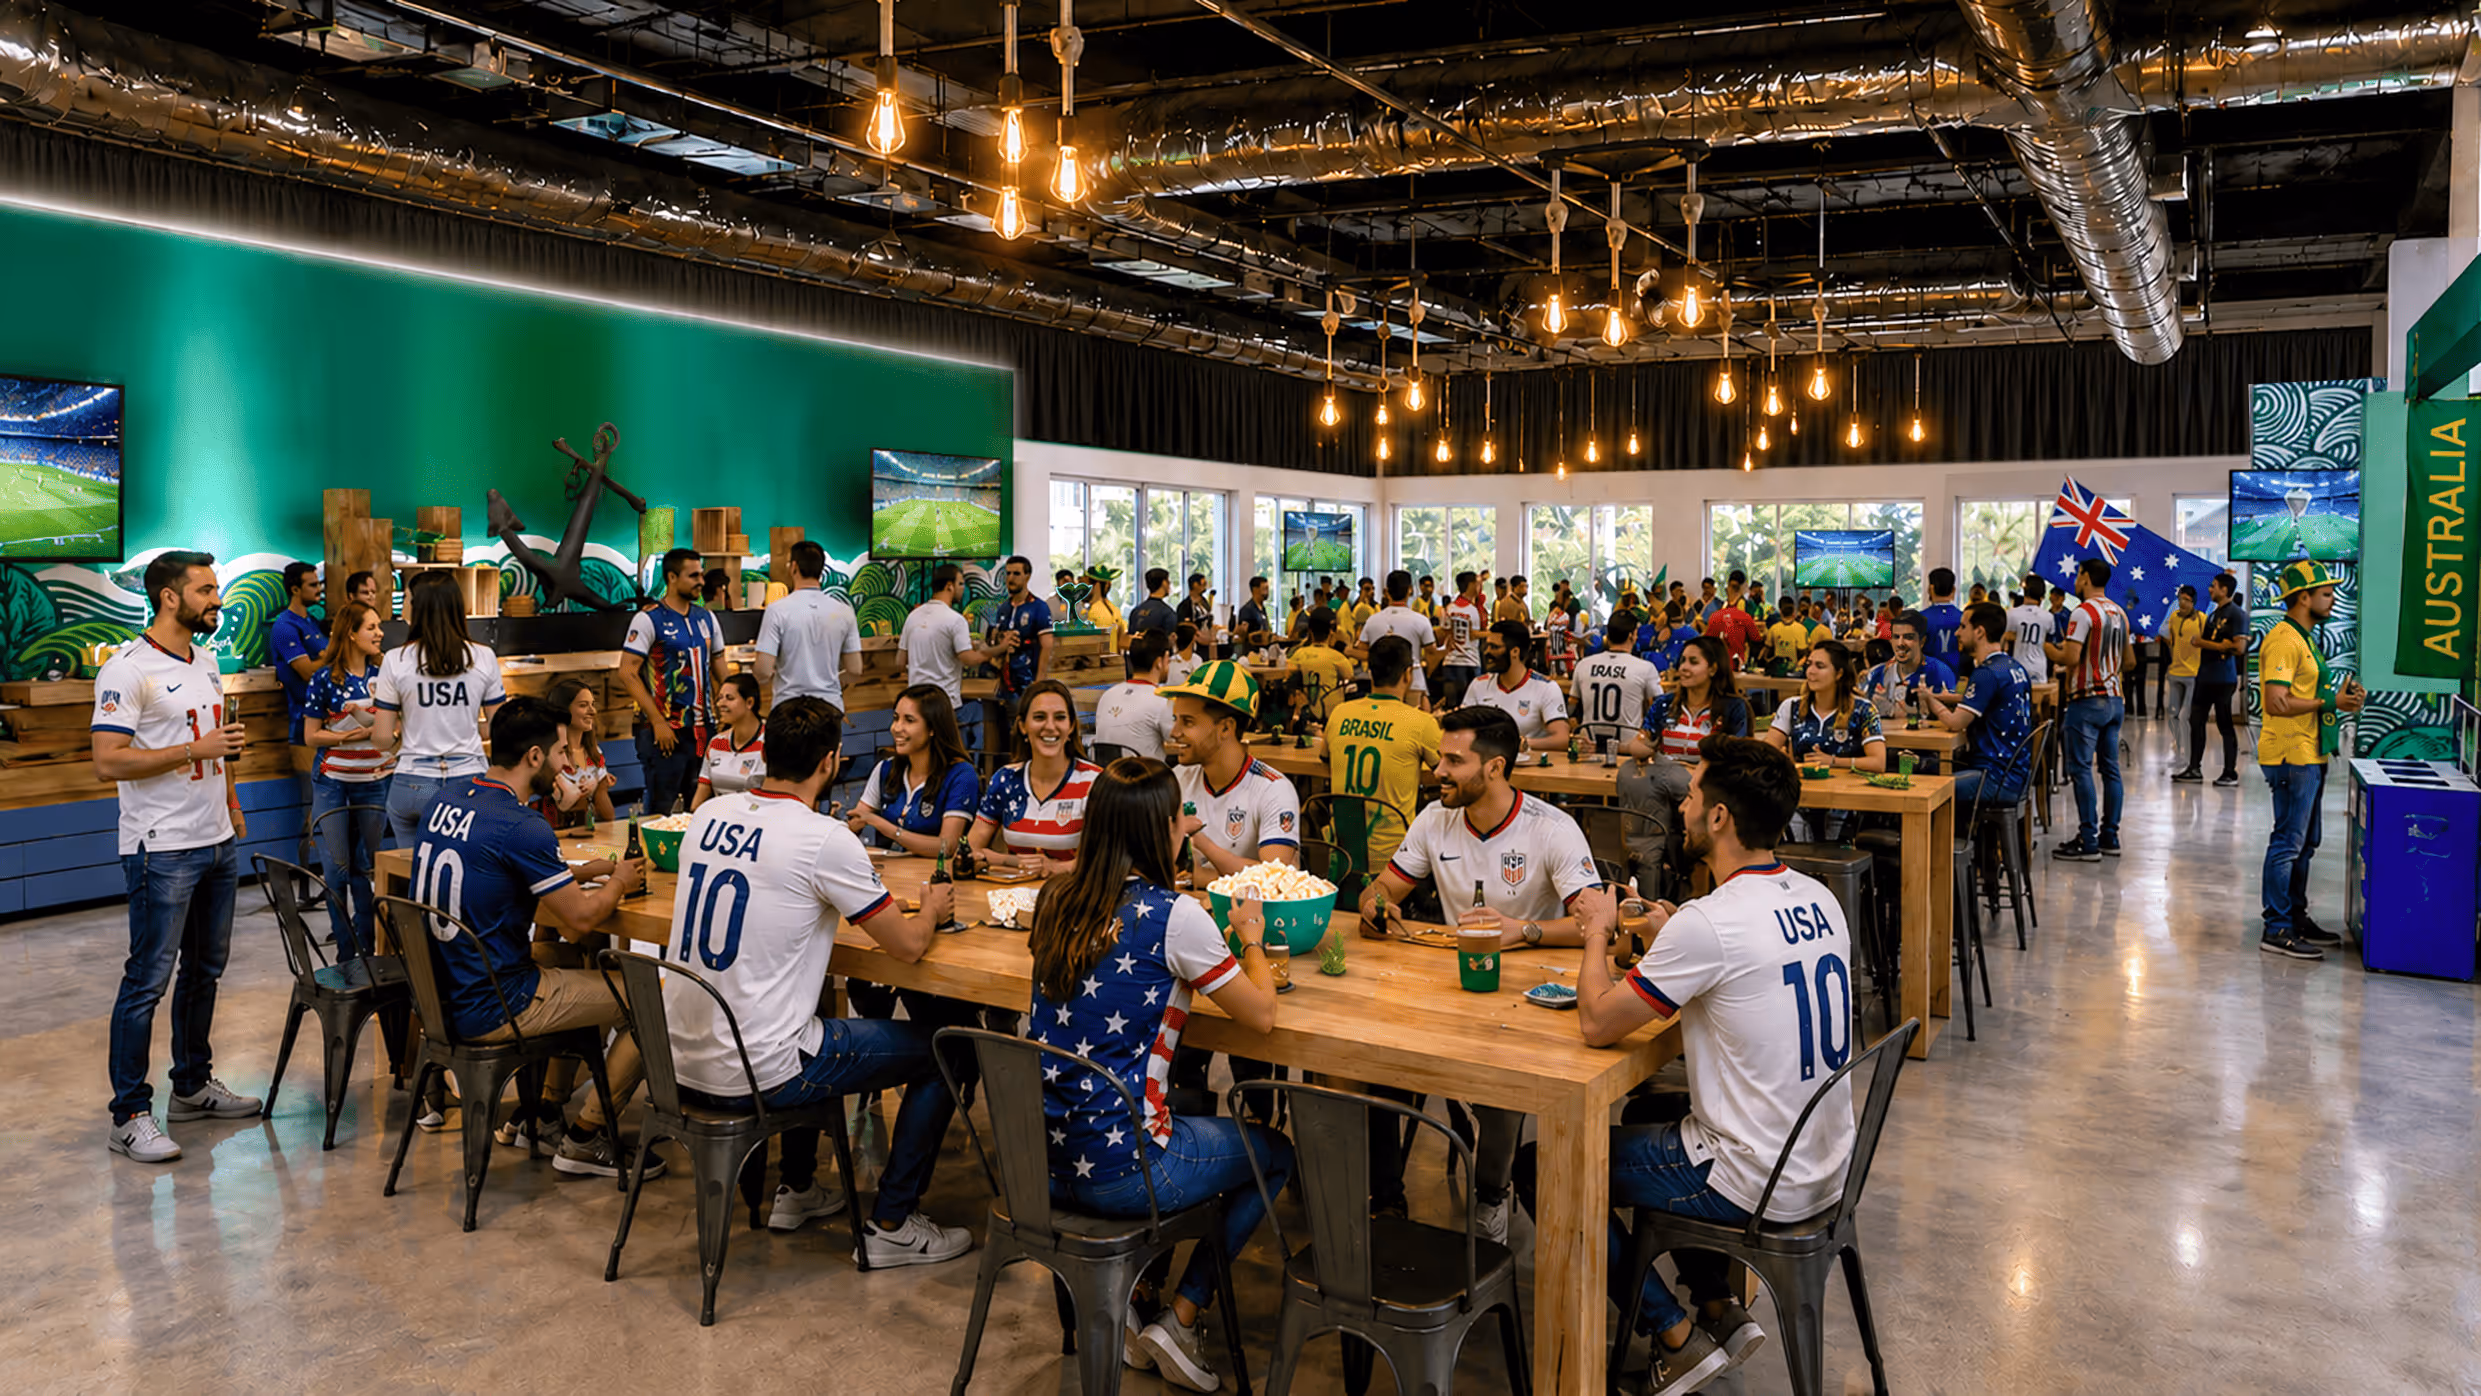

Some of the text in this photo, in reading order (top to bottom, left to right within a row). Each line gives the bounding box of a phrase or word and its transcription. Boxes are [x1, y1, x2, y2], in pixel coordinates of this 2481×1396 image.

[2423, 417, 2467, 660] AUSTRALIA
[417, 681, 469, 708] USA
[1590, 683, 1622, 722] 10
[1339, 718, 1395, 741] BRASIL
[1343, 744, 1381, 797] 10
[428, 802, 476, 842] USA
[699, 818, 763, 862] USA
[415, 841, 464, 942] 10
[679, 862, 750, 972] 10
[1773, 902, 1835, 945] USA
[1782, 953, 1850, 1082] 10
